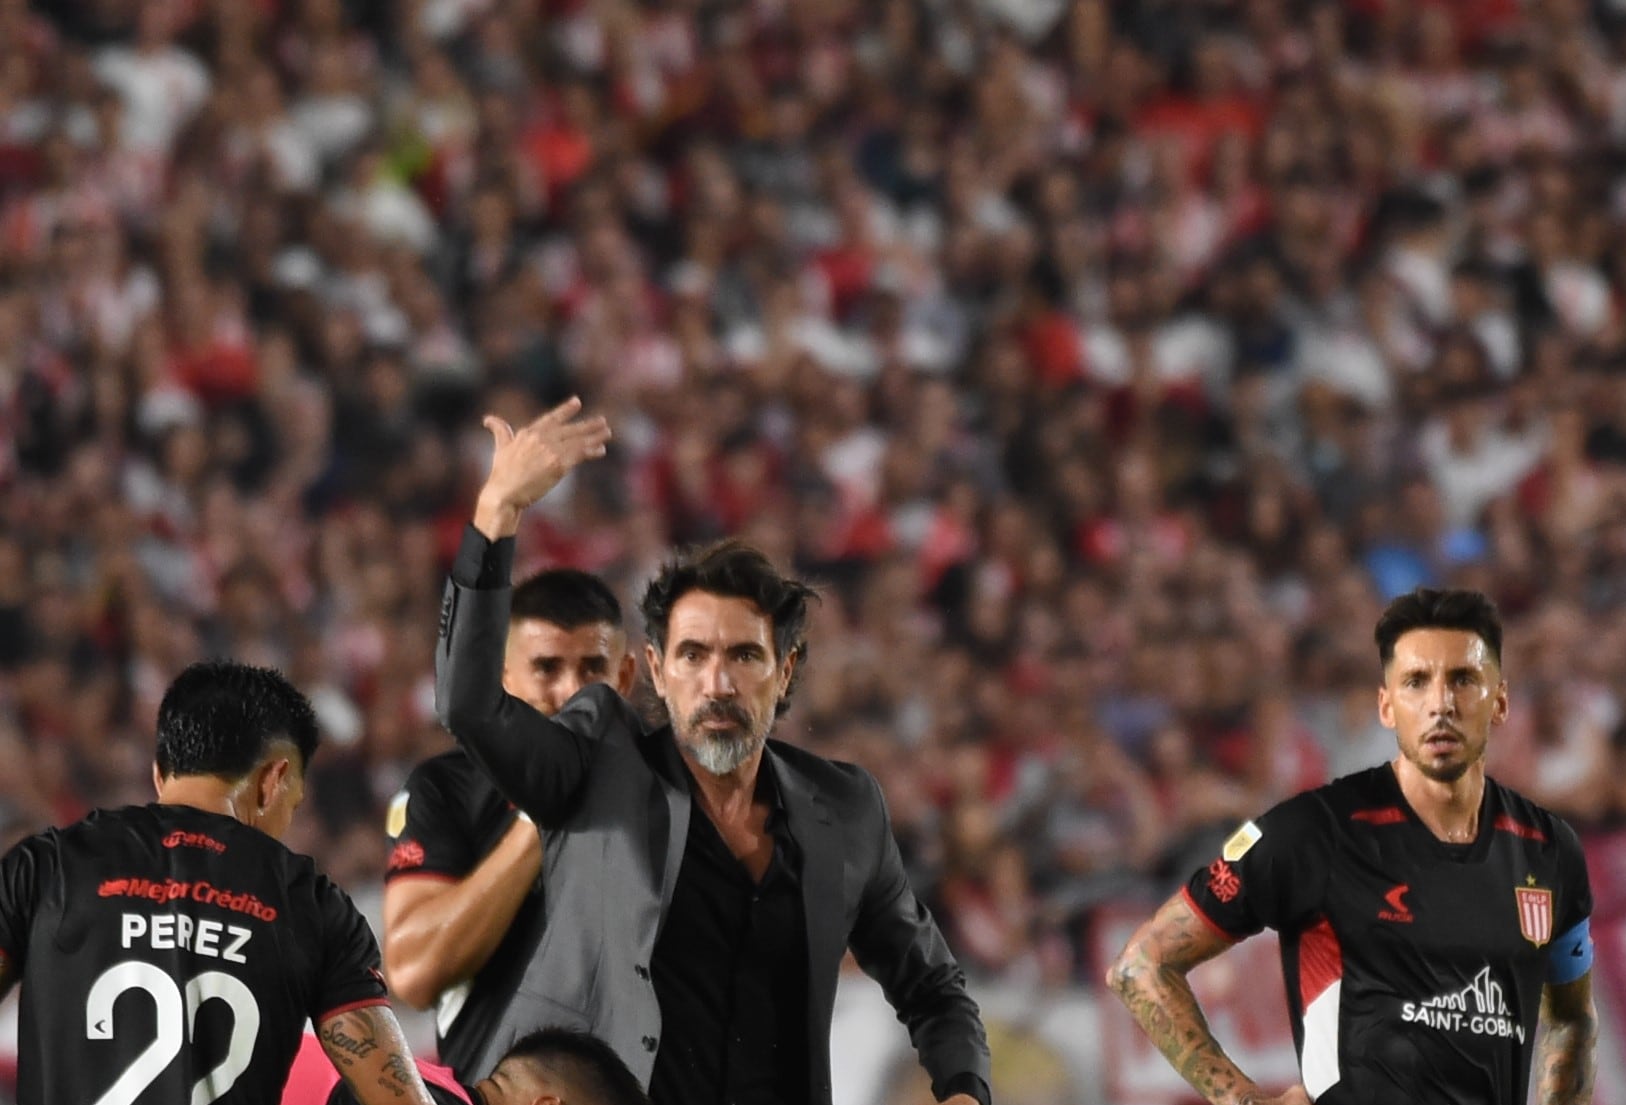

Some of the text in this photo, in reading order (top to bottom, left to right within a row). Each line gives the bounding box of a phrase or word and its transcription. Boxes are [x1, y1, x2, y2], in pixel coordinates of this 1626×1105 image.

[127, 878, 278, 922] Mejor Crédito
[121, 912, 252, 964] PEREZ
